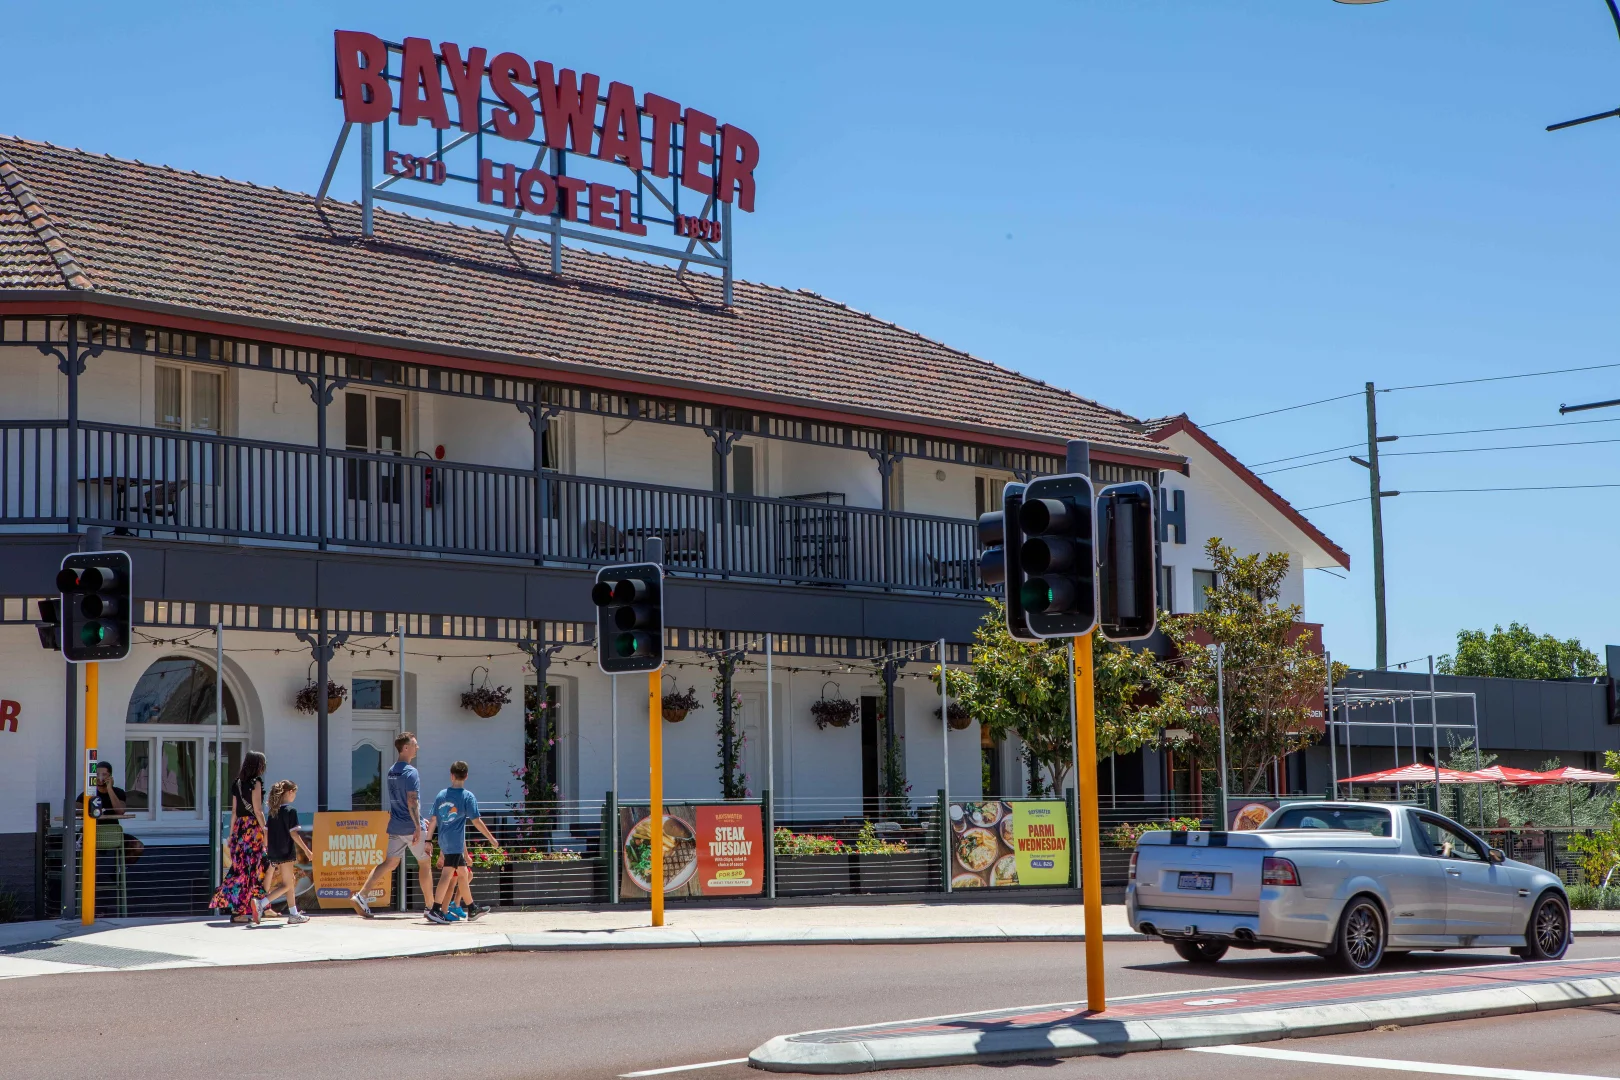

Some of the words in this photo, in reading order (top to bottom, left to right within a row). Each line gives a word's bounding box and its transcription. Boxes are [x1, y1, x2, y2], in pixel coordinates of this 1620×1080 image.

[334, 29, 759, 213] BAYSWATER
[385, 150, 447, 185] ESTD
[480, 158, 648, 237] HOTEL
[676, 214, 721, 242] 1898
[1076, 666, 1083, 677] 5
[715, 826, 746, 841] STEAK
[1028, 824, 1055, 837] PARMI
[328, 833, 378, 850] MONDAY
[709, 841, 753, 857] TUESDAY
[1018, 838, 1067, 851] WEDNESDAY
[322, 851, 347, 867] PUB
[348, 850, 383, 865] FAVES
